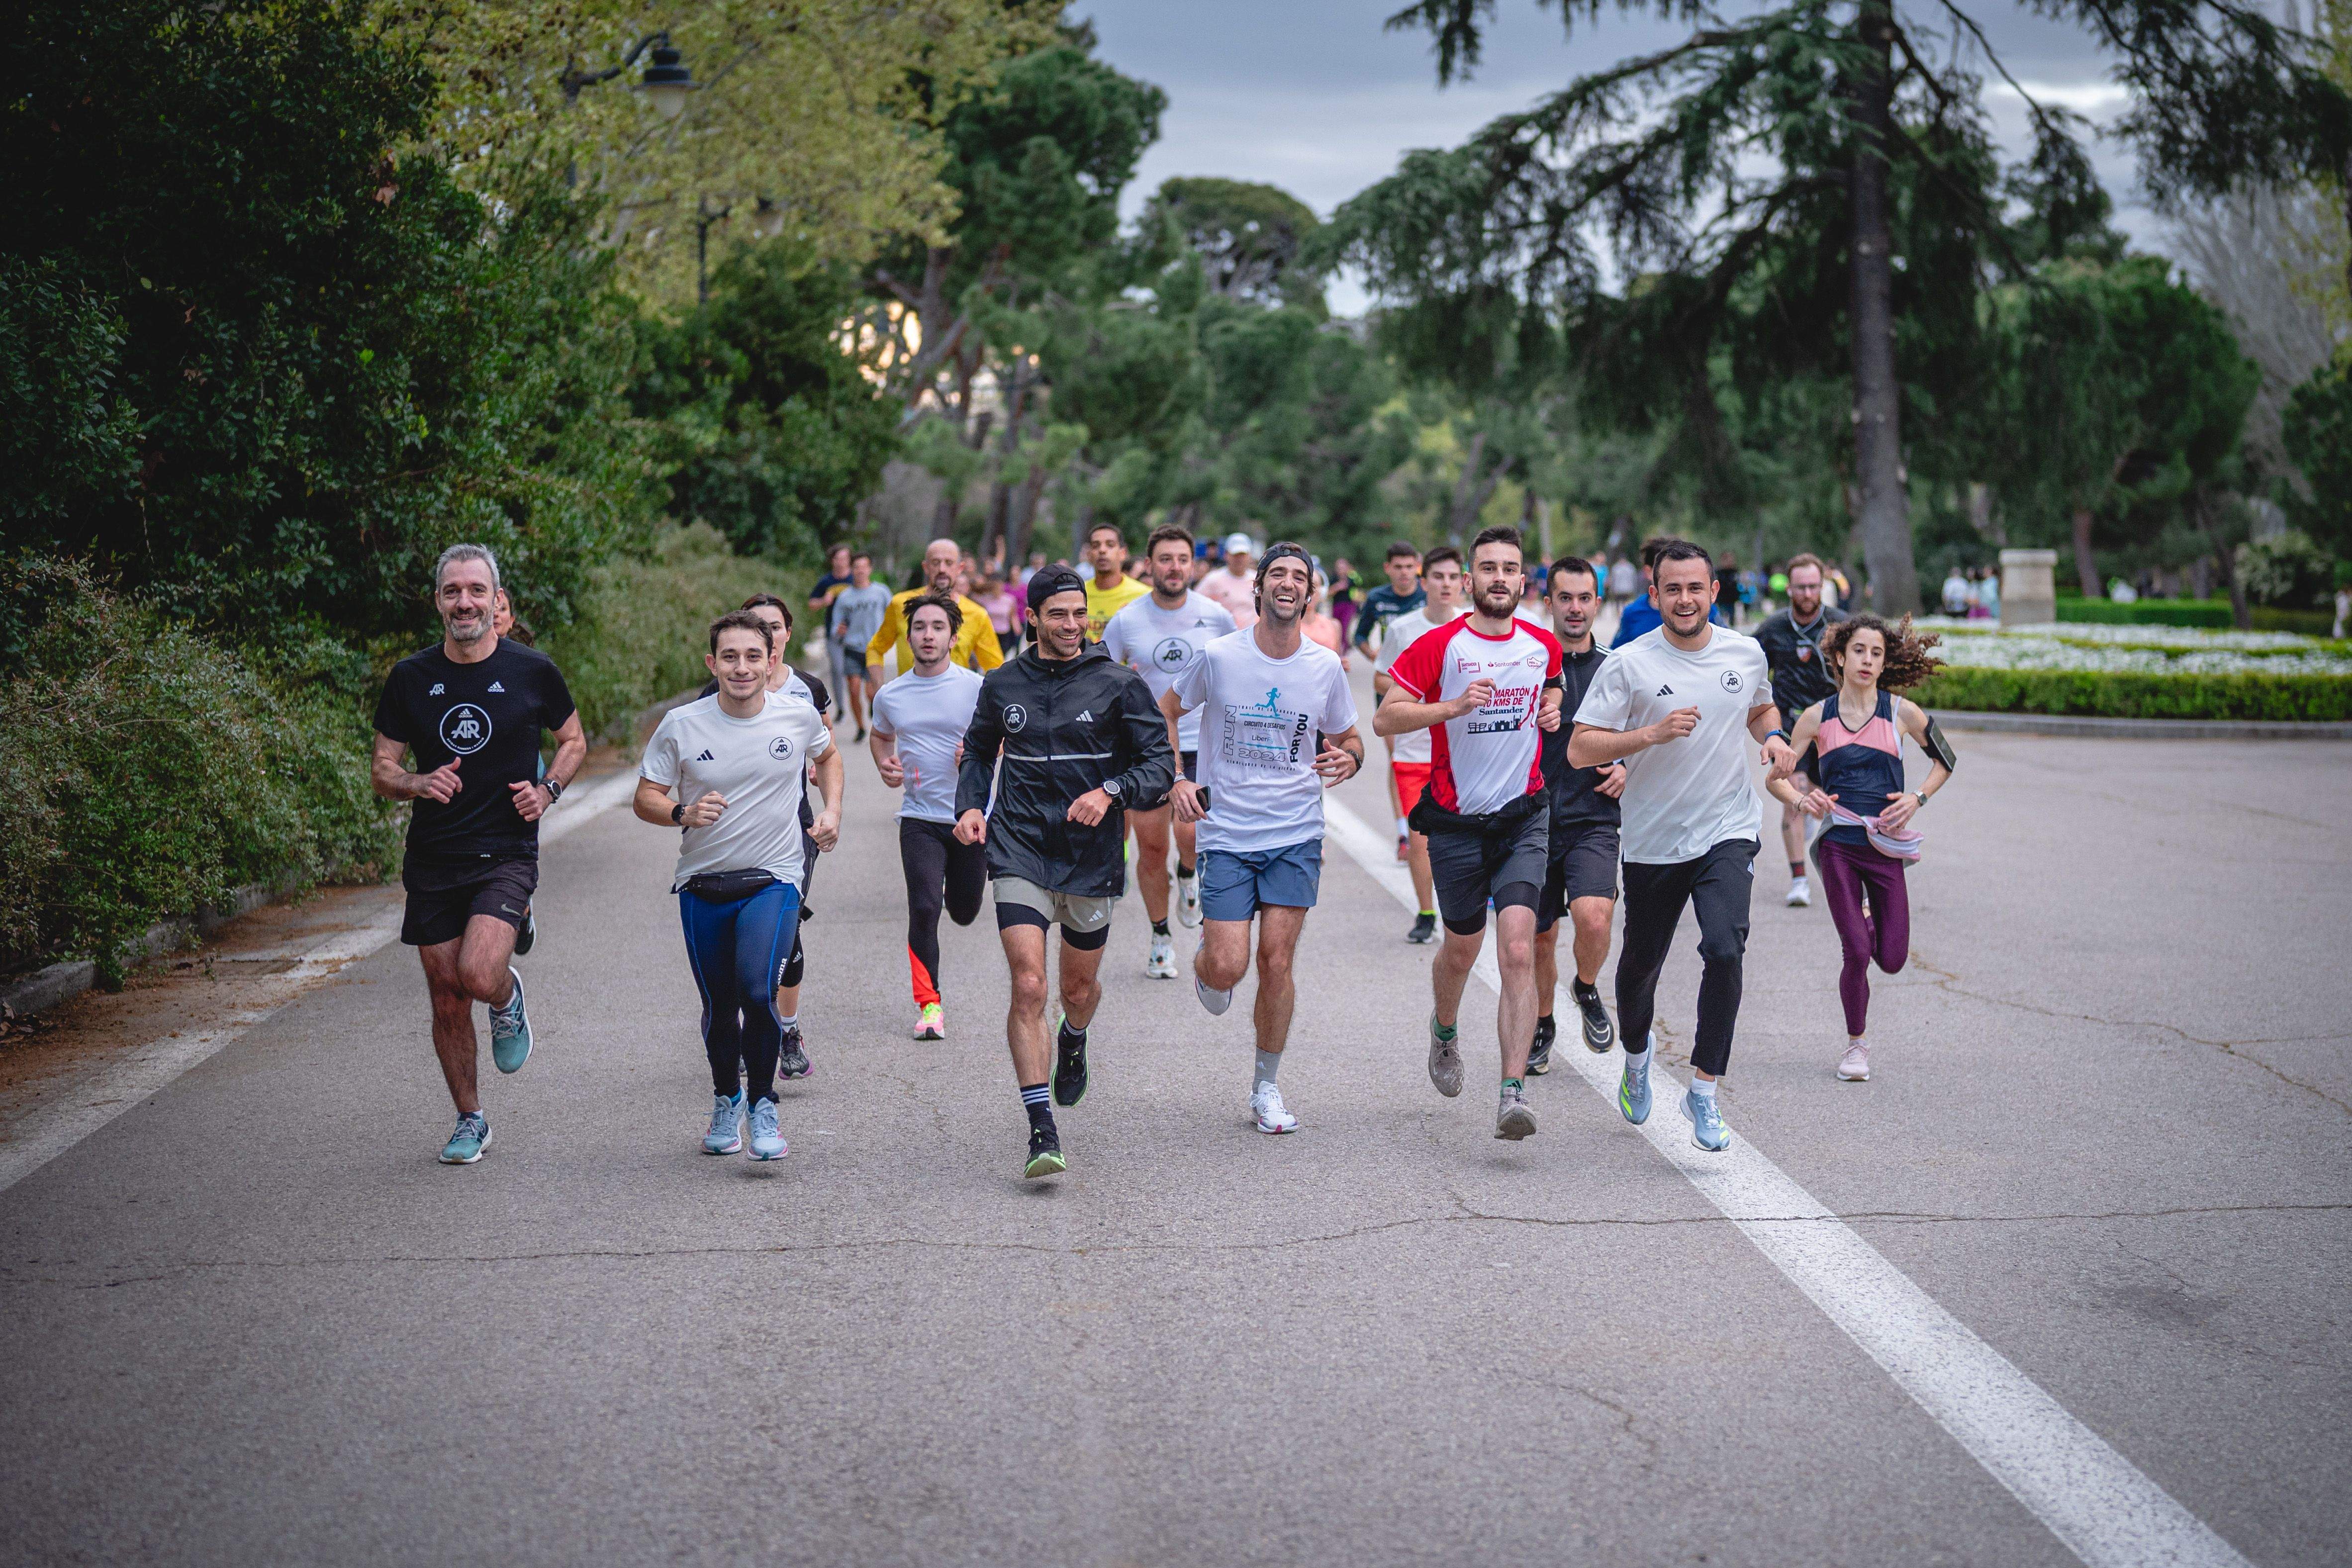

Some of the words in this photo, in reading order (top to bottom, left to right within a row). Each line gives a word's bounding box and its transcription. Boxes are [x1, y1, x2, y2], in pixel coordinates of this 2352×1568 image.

[1162, 648, 1183, 662] AR
[1726, 677, 1739, 686] AR
[429, 684, 445, 696] AR
[1494, 686, 1530, 698] MARATÓN
[1493, 697, 1511, 707] KMS
[1512, 697, 1524, 705] DE
[1479, 706, 1524, 716] Santander
[1007, 713, 1020, 724] AR
[451, 720, 480, 738] AR
[1223, 705, 1237, 755] RUN
[1293, 714, 1308, 738] YOU
[775, 744, 788, 753] AR
[1290, 739, 1301, 763] FOR
[1238, 748, 1286, 762] 2024
